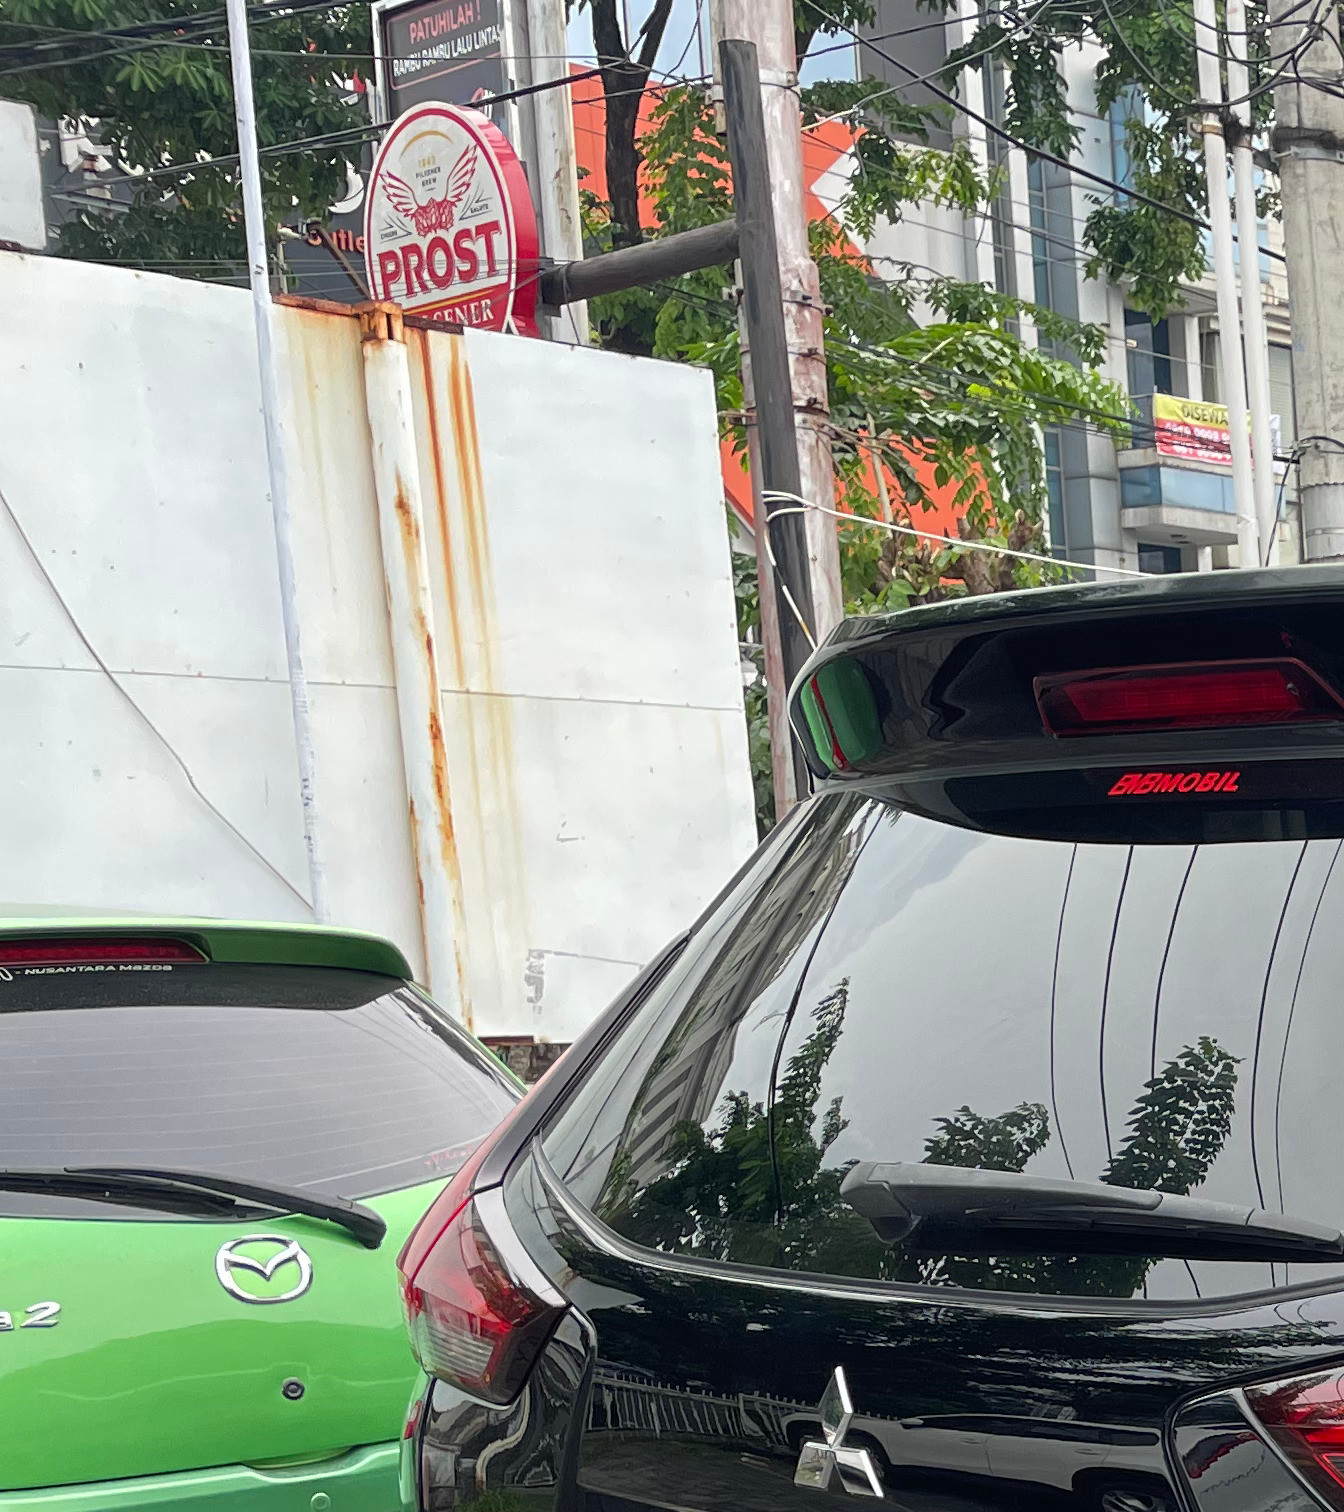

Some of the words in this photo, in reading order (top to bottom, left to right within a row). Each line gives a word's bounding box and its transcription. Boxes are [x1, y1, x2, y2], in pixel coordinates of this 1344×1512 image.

[409, 3, 474, 44] PATUHILAH
[450, 33, 472, 57] LALU
[376, 220, 502, 303] PROST
[24, 965, 116, 976] NUSANTARA
